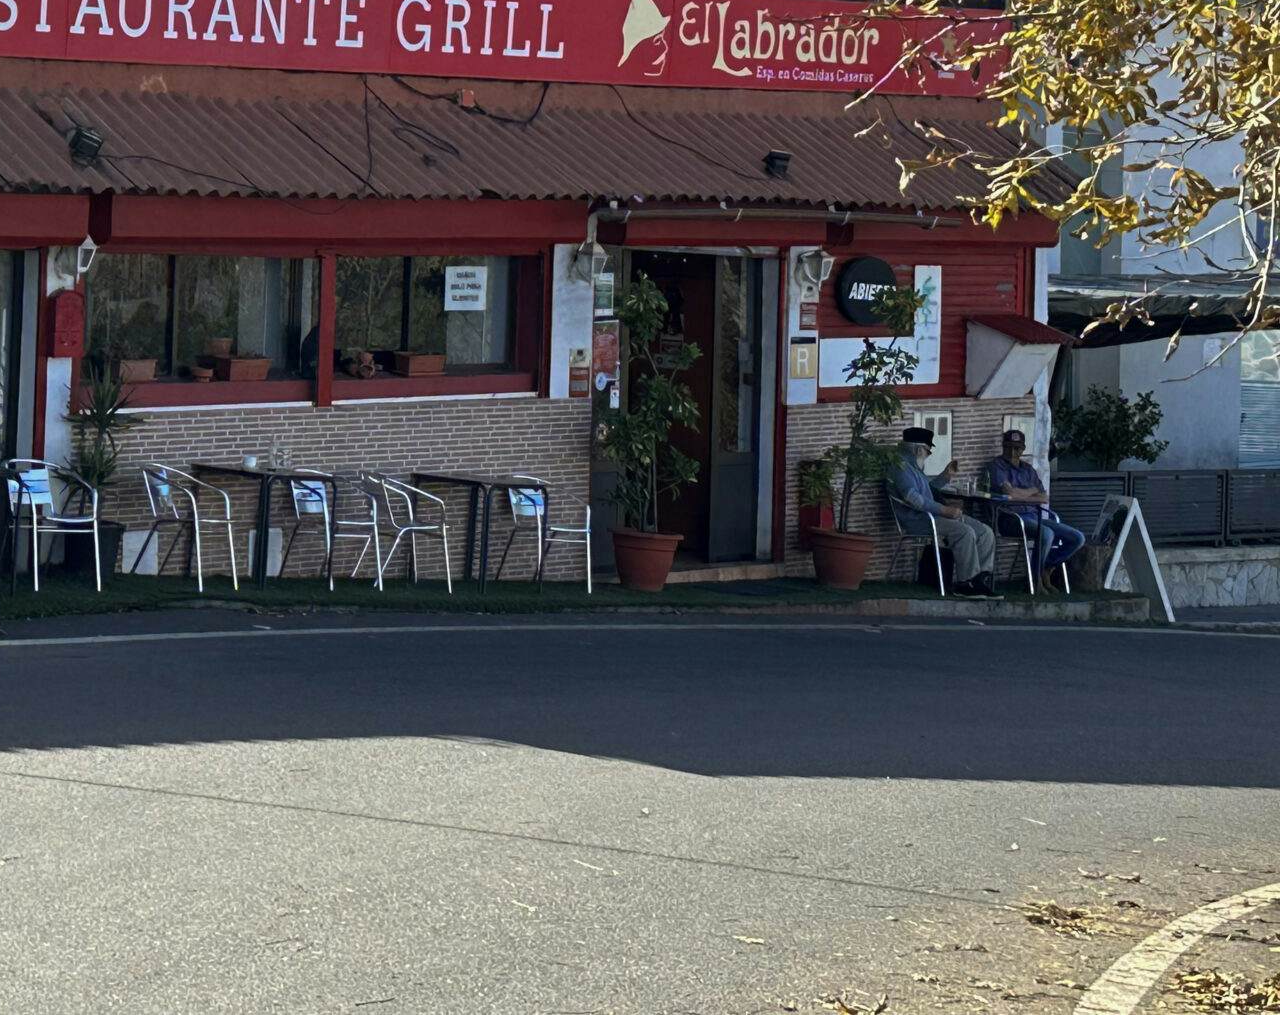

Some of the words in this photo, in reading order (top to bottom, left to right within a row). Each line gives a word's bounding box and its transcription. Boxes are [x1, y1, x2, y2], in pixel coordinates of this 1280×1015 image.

[712, 0, 880, 77] Labrador
[848, 282, 897, 301] ABIE
[797, 347, 810, 376] R
